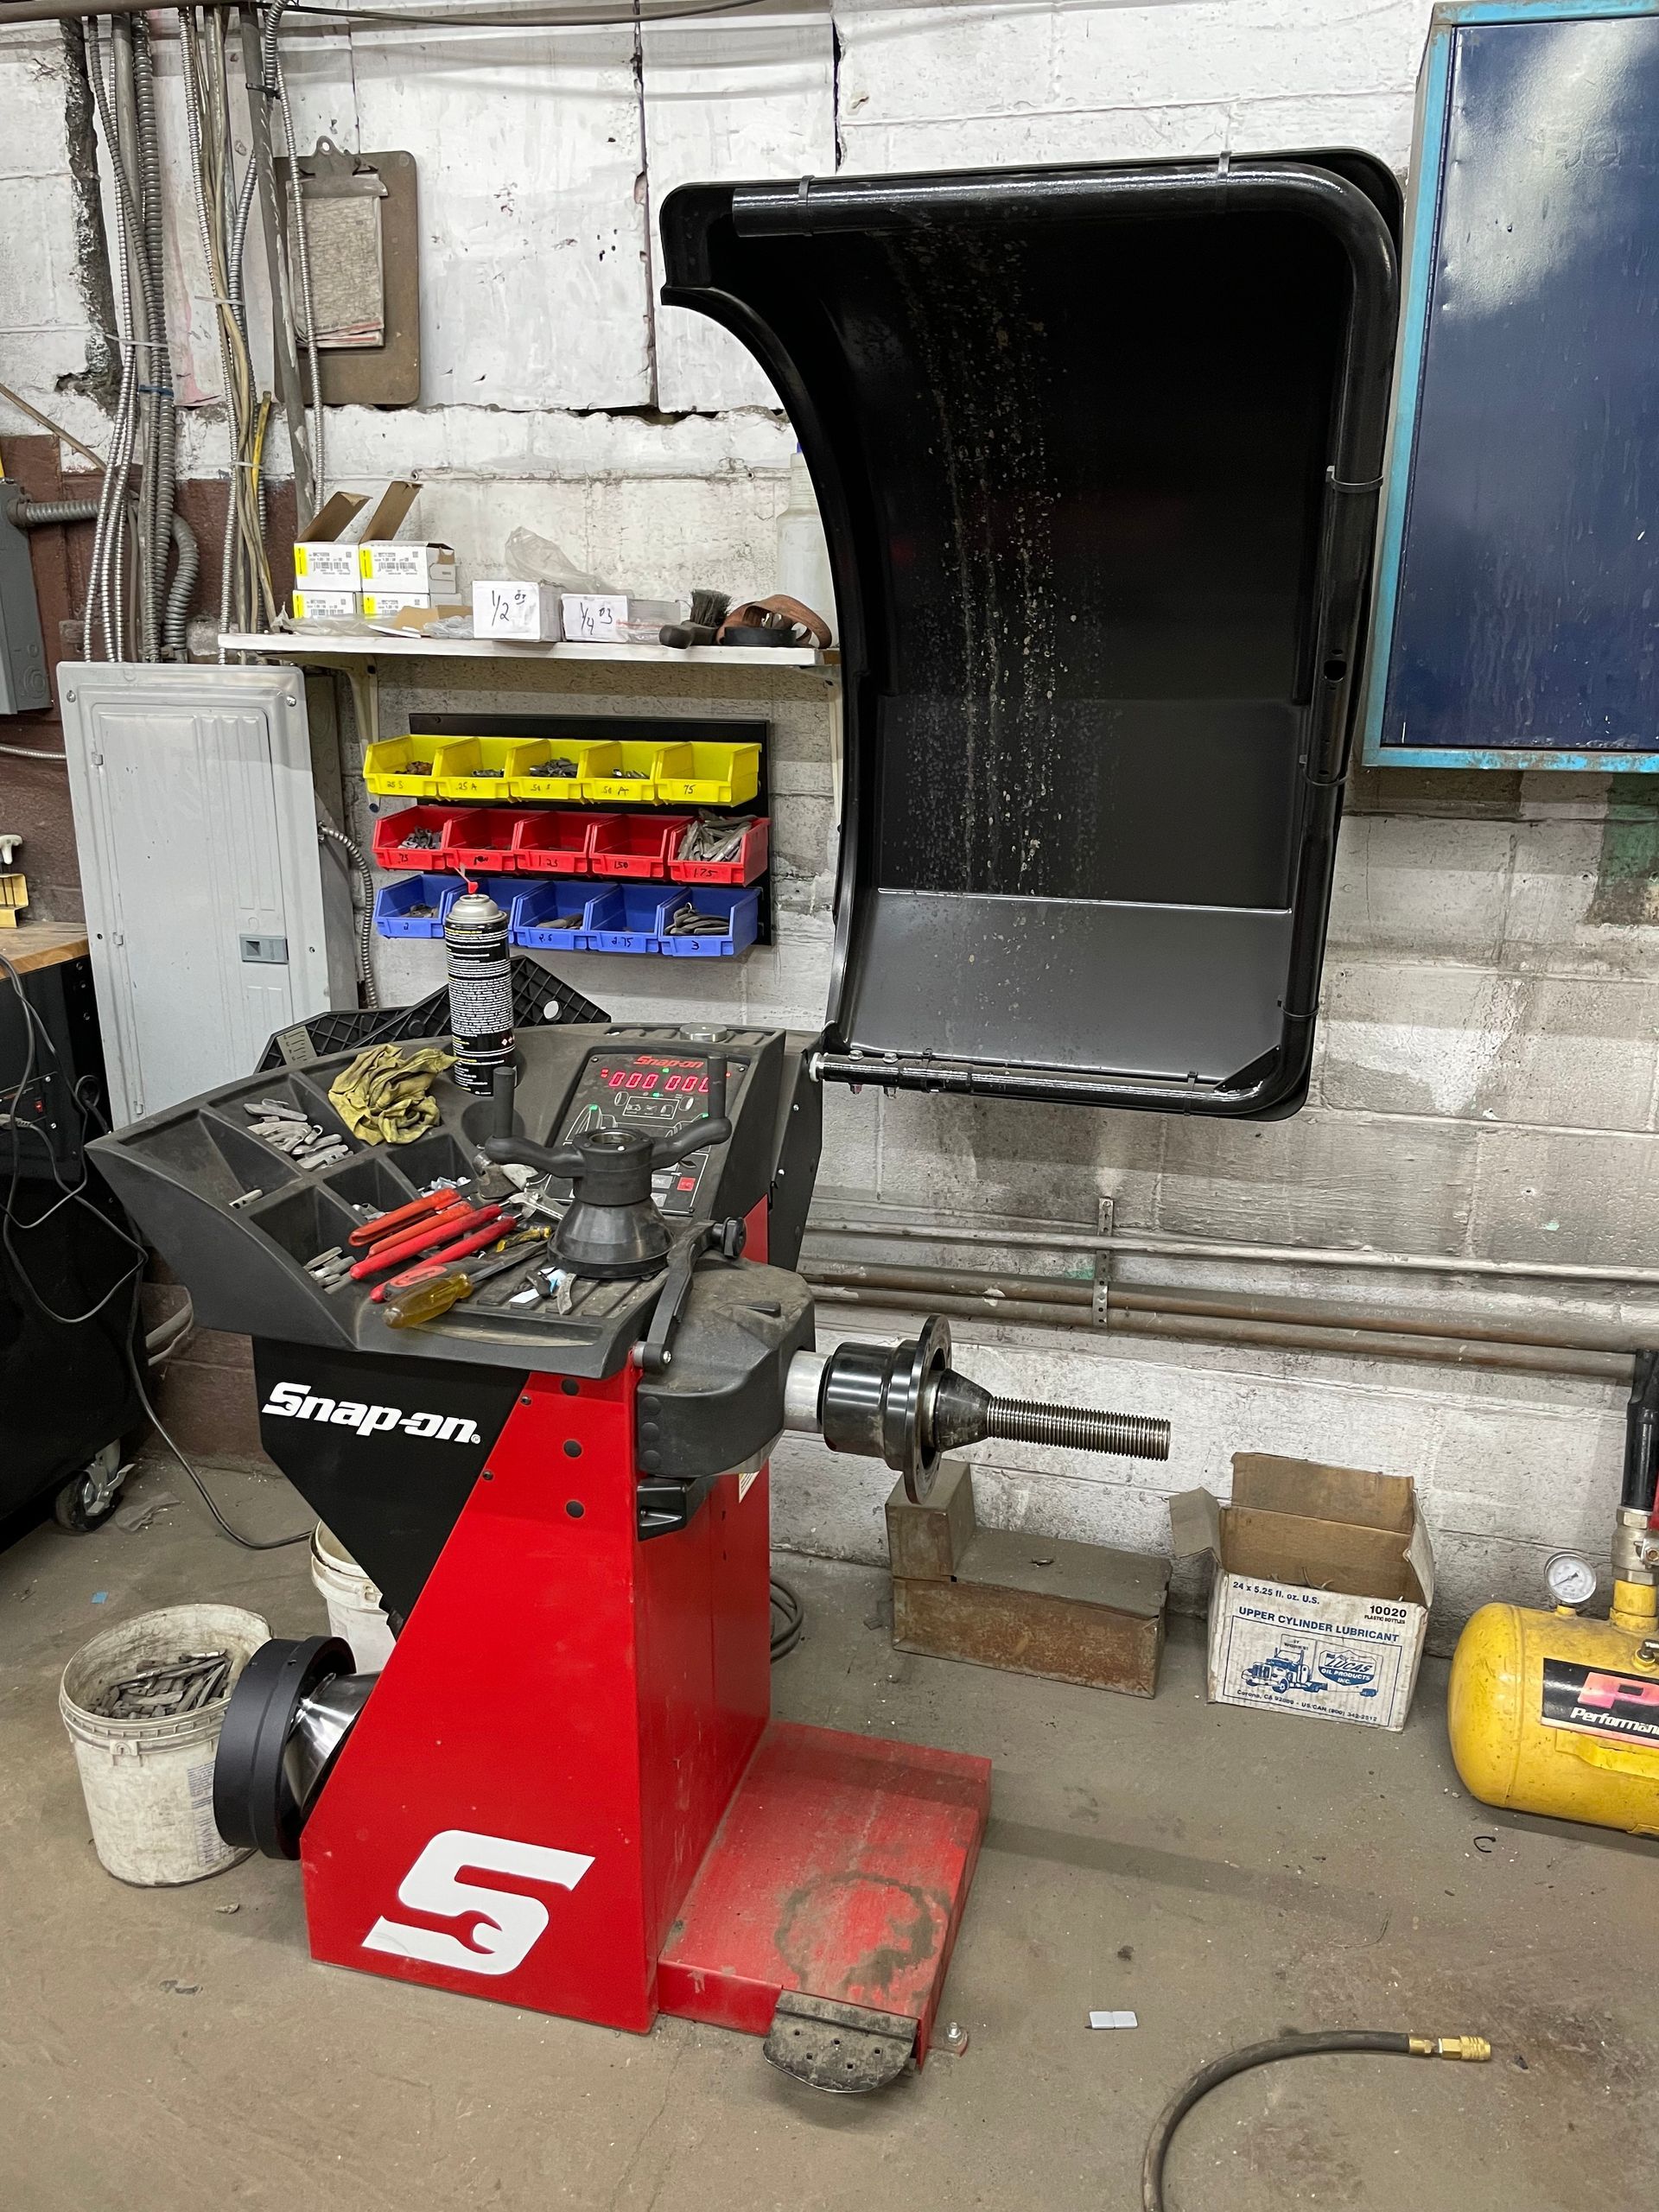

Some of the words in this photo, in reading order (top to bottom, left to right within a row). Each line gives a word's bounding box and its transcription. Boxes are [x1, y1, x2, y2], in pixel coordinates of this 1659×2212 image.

[691, 940, 700, 950] 3
[1232, 1581, 1244, 1591] 24
[1254, 1586, 1273, 1596] 5.25
[1287, 1593, 1300, 1602] oz.
[1302, 1594, 1320, 1605] U.S.
[1369, 1605, 1408, 1618] 10020
[1238, 1606, 1275, 1622] UPPER
[1278, 1615, 1333, 1633] CYLINDER
[1335, 1625, 1400, 1643] LUBRICANT
[1325, 1659, 1373, 1673] LUCAS
[1333, 1670, 1371, 1681] PRODUCTS
